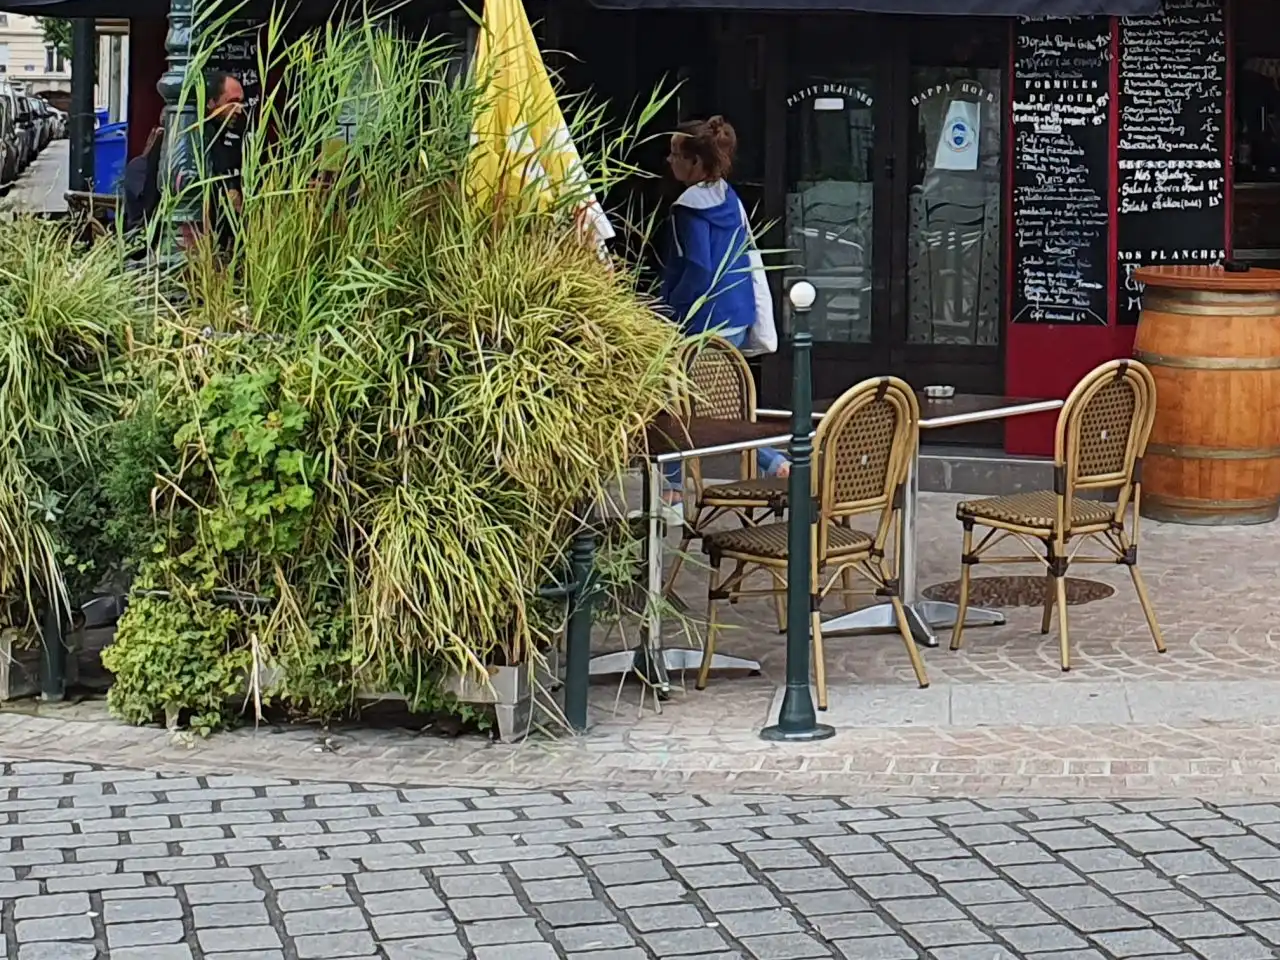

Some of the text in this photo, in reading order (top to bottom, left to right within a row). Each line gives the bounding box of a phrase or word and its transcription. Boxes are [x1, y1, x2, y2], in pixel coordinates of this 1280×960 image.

[1025, 80, 1098, 89] FORMULES
[1058, 94, 1093, 103] JOUR
[1118, 250, 1225, 260] NOS PLANCHES
